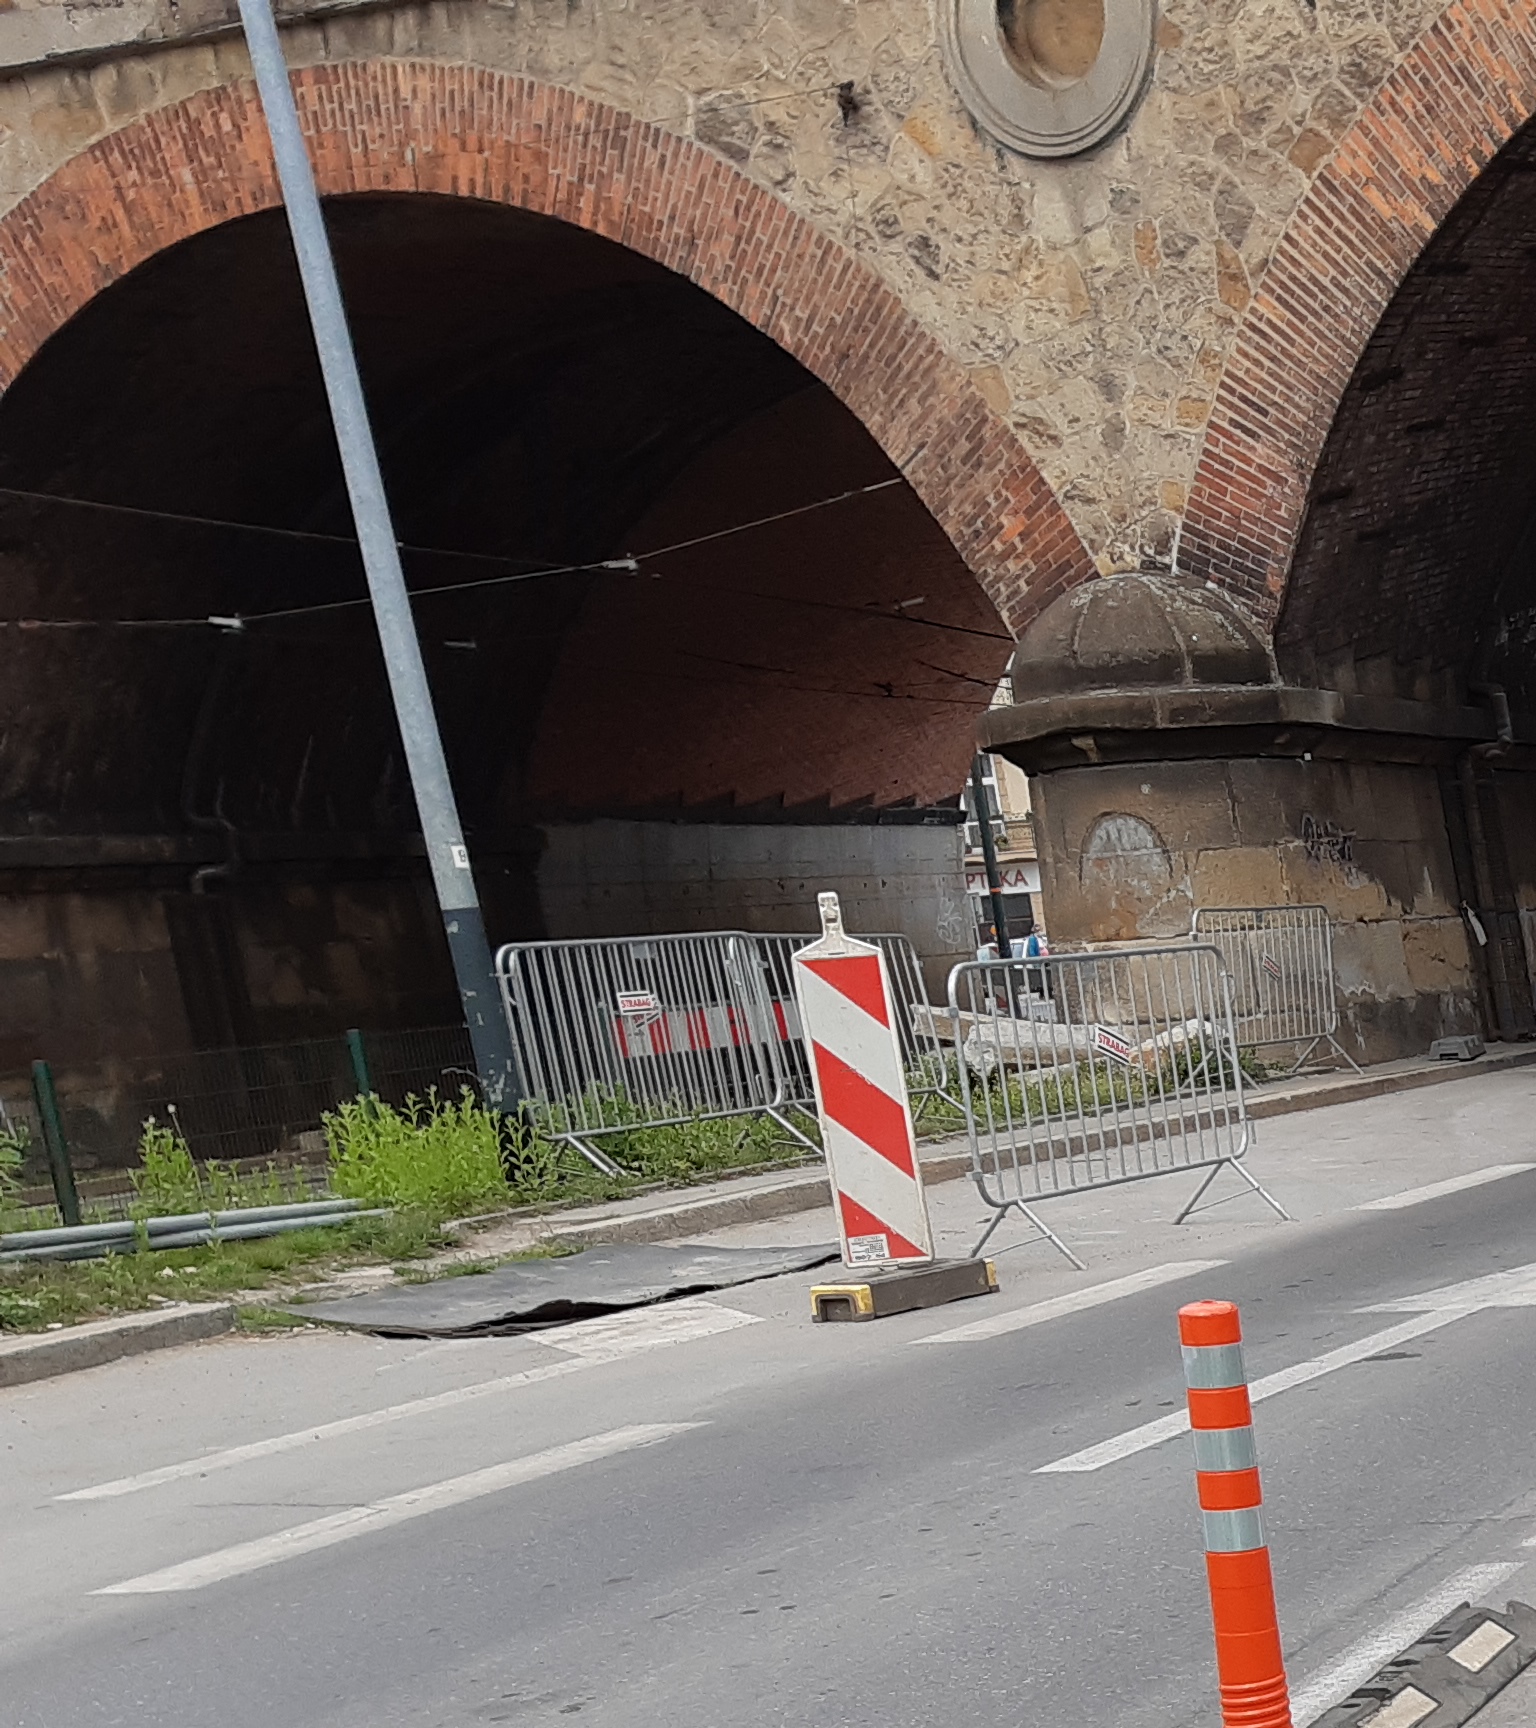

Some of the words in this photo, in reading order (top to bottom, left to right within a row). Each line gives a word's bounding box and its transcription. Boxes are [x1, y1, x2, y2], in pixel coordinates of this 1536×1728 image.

[966, 868, 1029, 891] PTKA
[620, 997, 652, 1009] STRABAG
[1097, 1032, 1131, 1059] STRABAG
